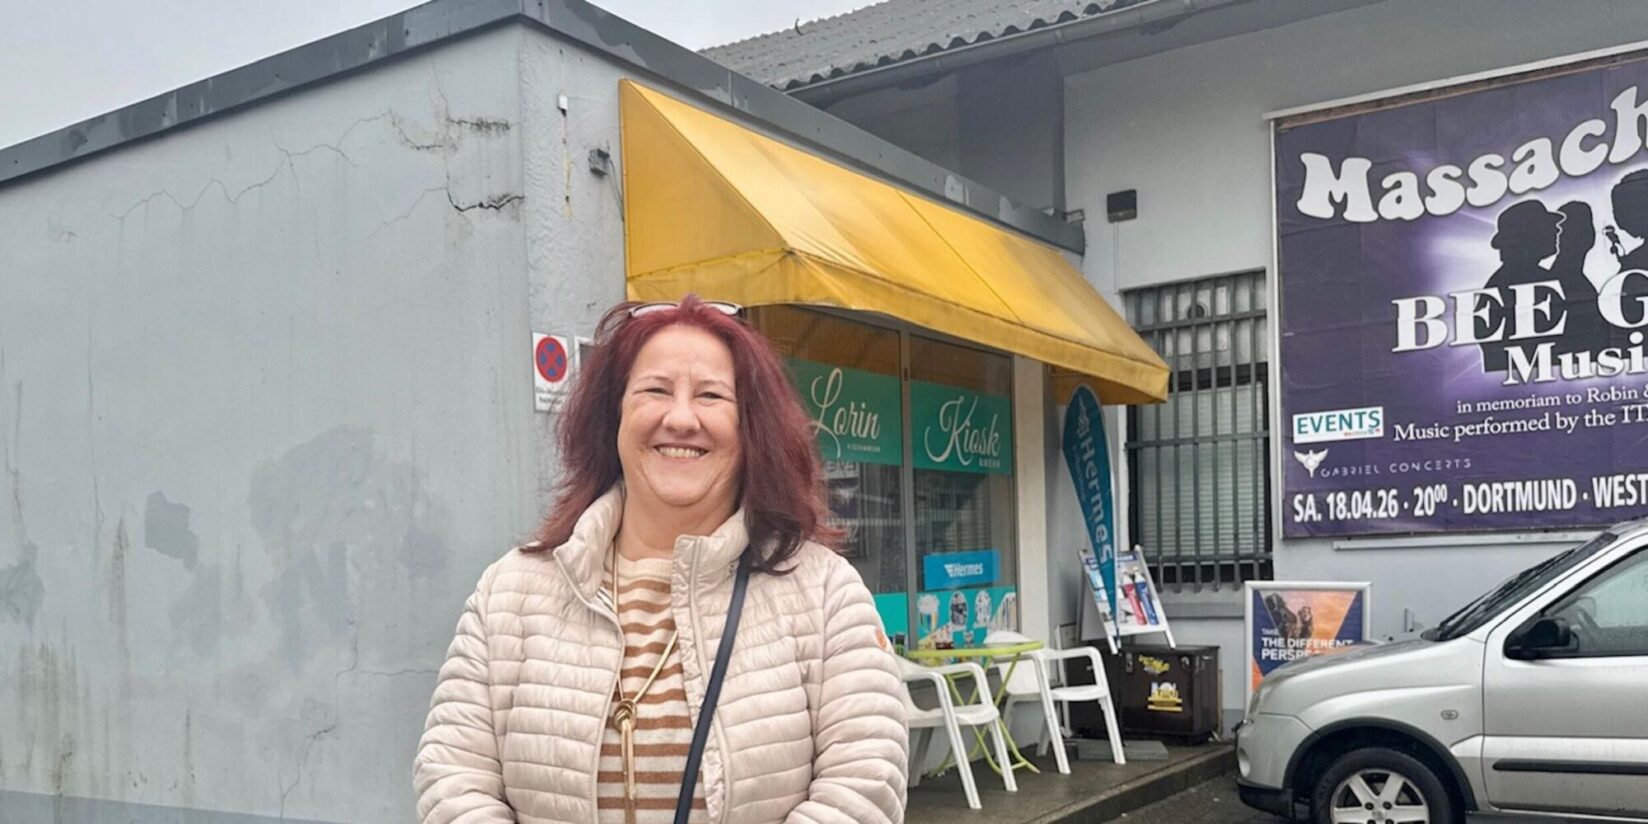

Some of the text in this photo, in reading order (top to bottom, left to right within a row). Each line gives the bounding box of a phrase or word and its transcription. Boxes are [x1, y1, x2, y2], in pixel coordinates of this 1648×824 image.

[1391, 280, 1568, 353] BEE
[808, 368, 880, 459] Lorin
[1457, 400, 1472, 414] in
[1476, 393, 1561, 412] memoriam
[1566, 392, 1582, 405] to
[1587, 385, 1638, 403] Robin
[924, 395, 1000, 466] Kiosk
[1296, 410, 1381, 435] EVENTS
[1393, 403, 1648, 442] Music performed by the IT
[1320, 458, 1472, 478] GABRIEL CONCERTS
[1080, 437, 1115, 565] Hermes
[1293, 493, 1322, 523] SA.
[1326, 488, 1399, 521] 18.04.26
[1463, 478, 1578, 514] DORTMUND
[953, 562, 984, 578] Hermes
[1262, 637, 1286, 648] THE
